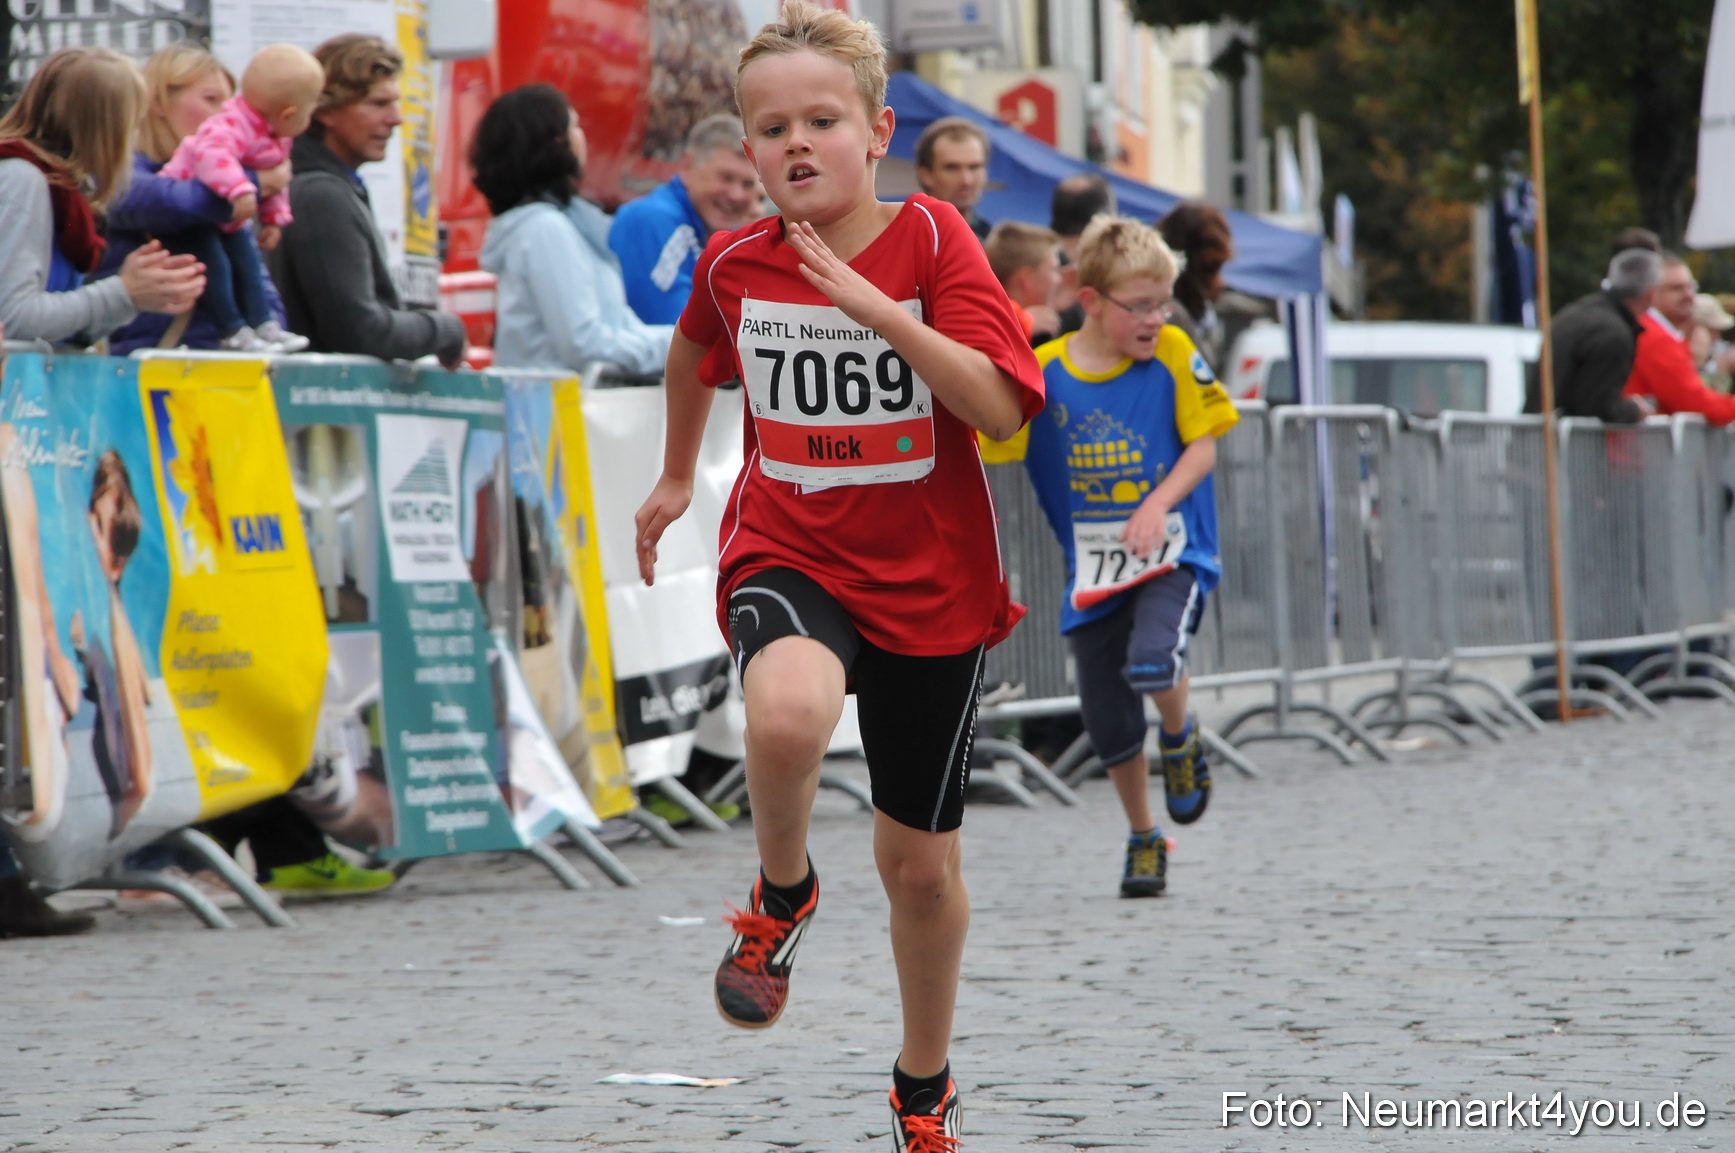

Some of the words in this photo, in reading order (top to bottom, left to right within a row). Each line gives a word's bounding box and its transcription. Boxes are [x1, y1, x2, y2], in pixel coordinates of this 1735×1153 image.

[742, 318, 795, 339] PARTL
[755, 347, 914, 416] 7069
[807, 434, 863, 460] Nick
